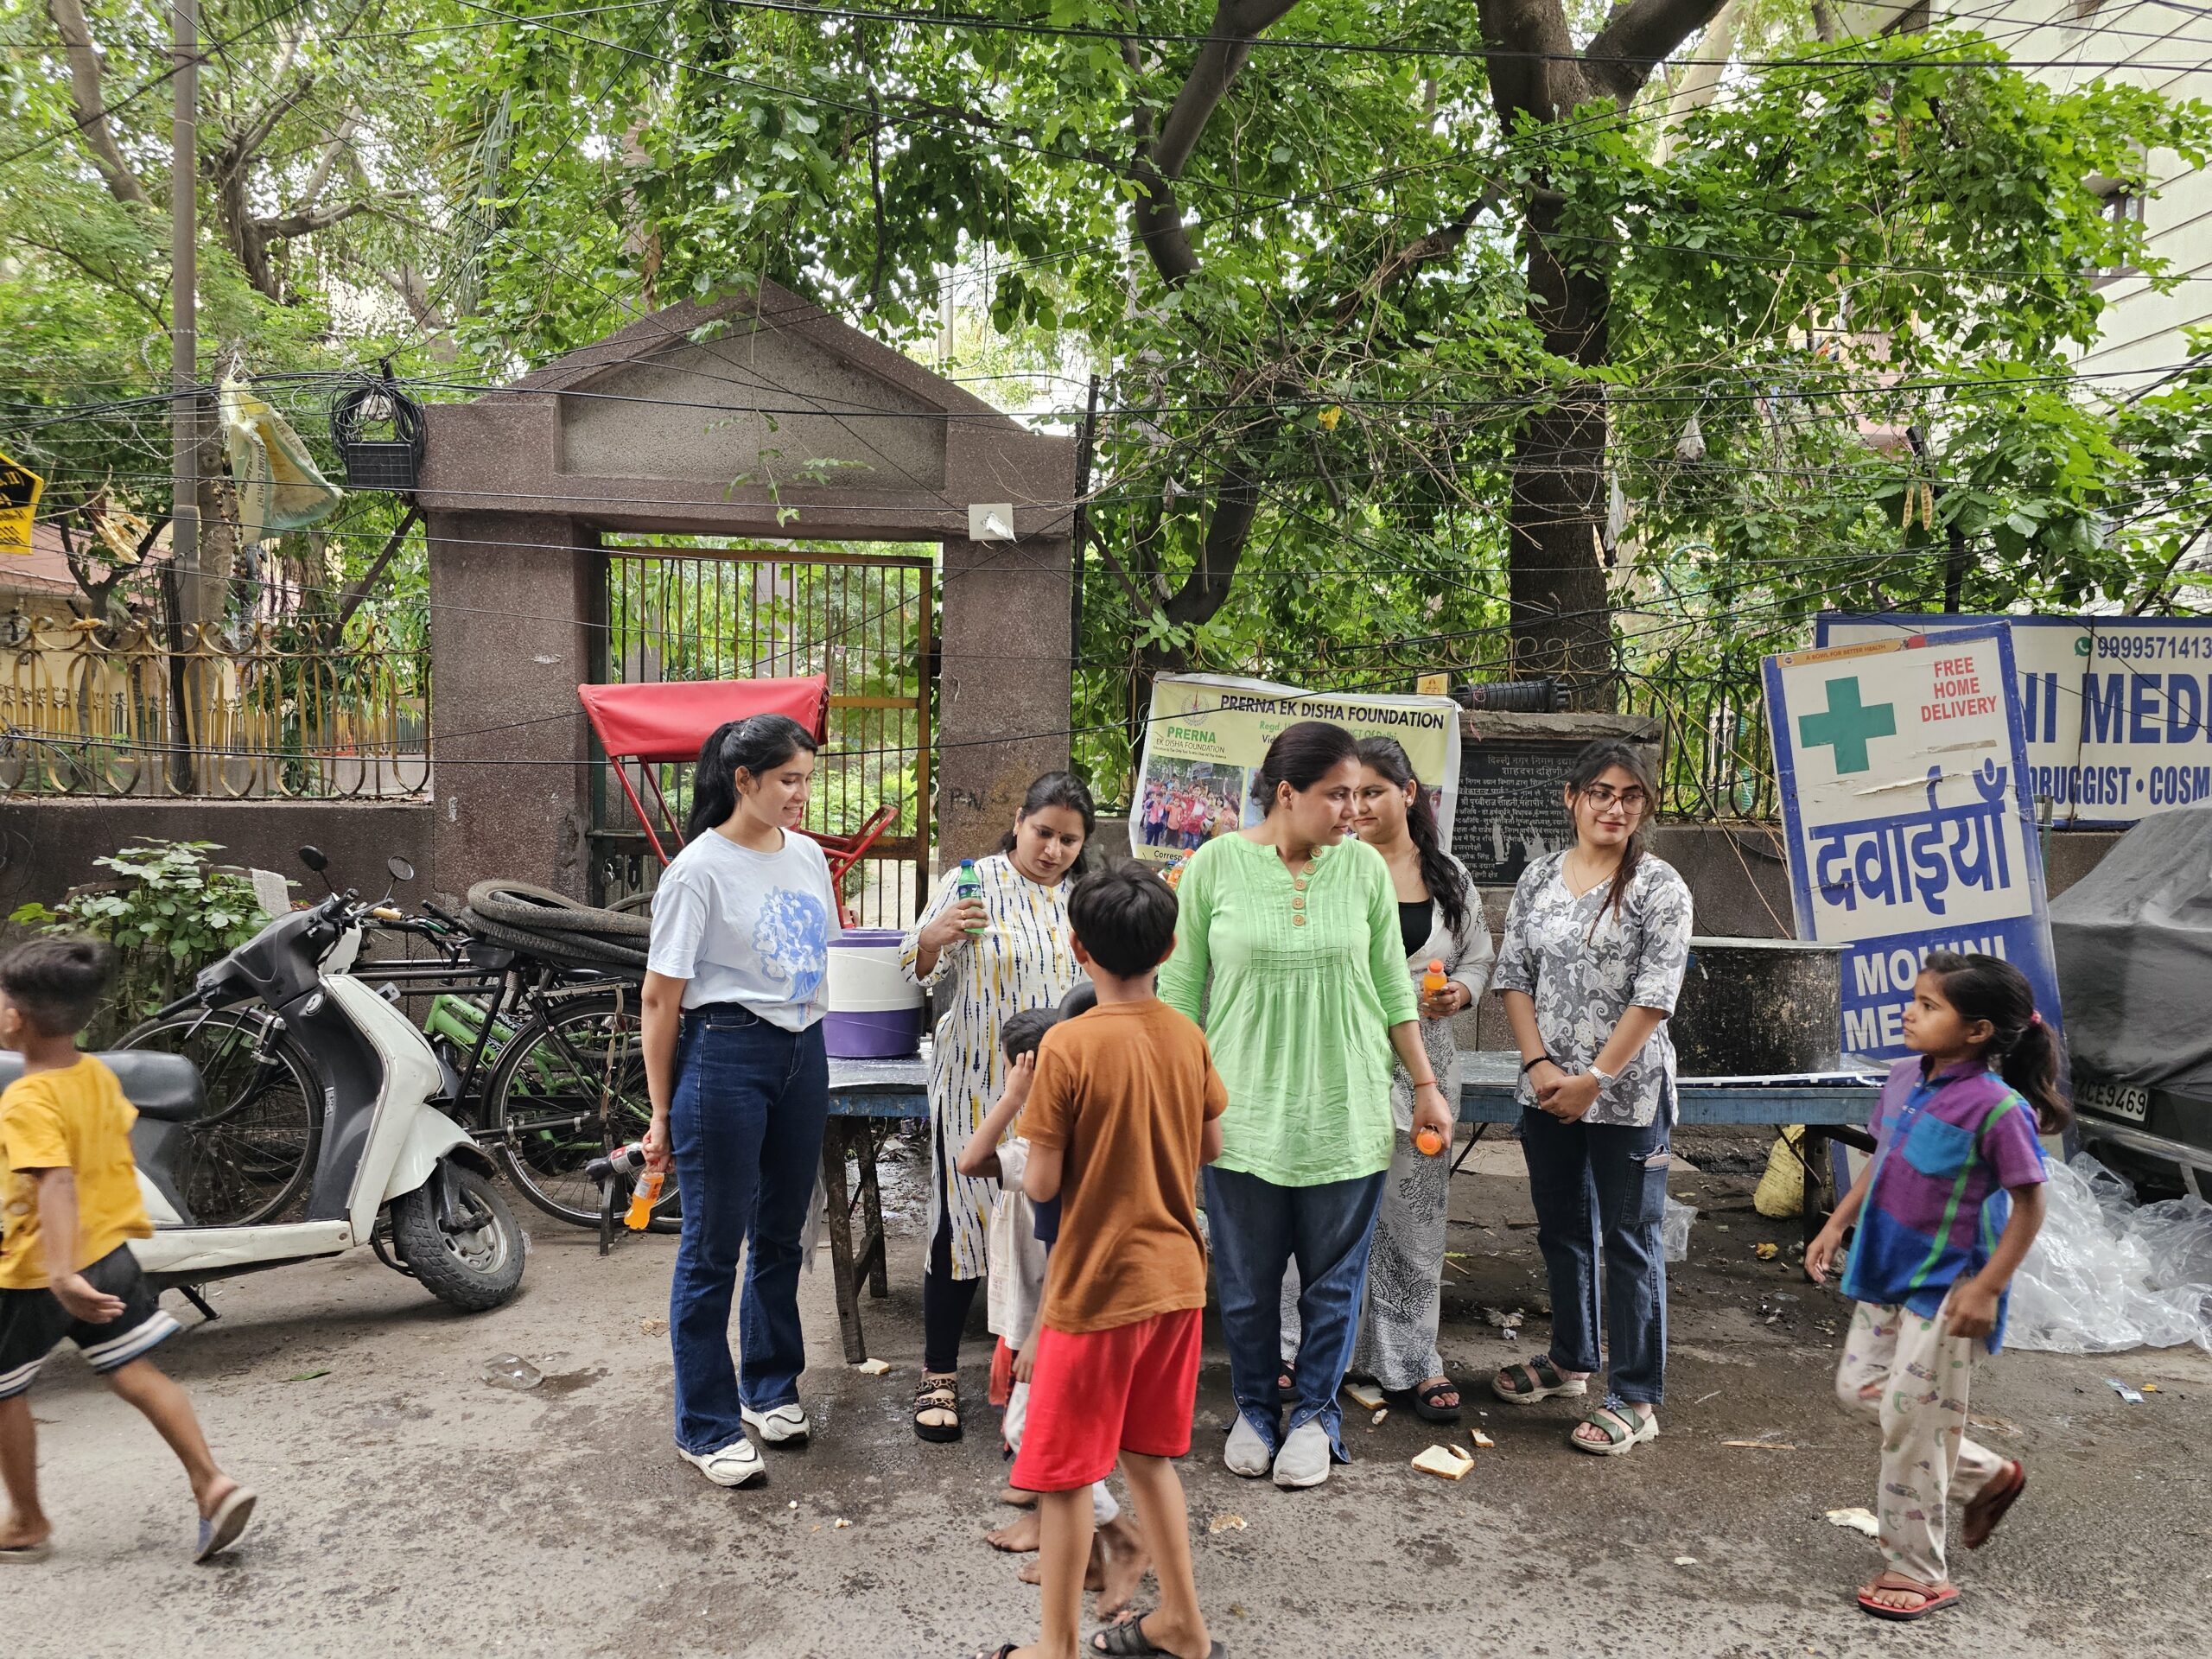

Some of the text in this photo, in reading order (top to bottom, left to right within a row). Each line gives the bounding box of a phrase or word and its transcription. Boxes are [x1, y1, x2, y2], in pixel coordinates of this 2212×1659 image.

[1864, 644, 1886, 652] HEALTH
[2097, 636, 2212, 659] 9999571413
[1934, 657, 1975, 678] FREE
[1934, 677, 1980, 700] HOME
[1220, 695, 1444, 730] PRERNA EK DISHA FOUNDATION
[1920, 696, 1998, 723] DELIVERY
[1167, 726, 1217, 744] PRERNA
[1259, 720, 1282, 732] Regd.
[1165, 739, 1184, 748] DISHA
[1185, 741, 1225, 753] FOUNDATION
[1488, 754, 1510, 766] दिल्ली
[1531, 754, 1554, 765] निगम
[1502, 767, 1534, 776] शाहदरा
[1536, 766, 1562, 777] दक्षिणी
[2149, 766, 2212, 805] COSM
[1154, 850, 1184, 861] Corresp
